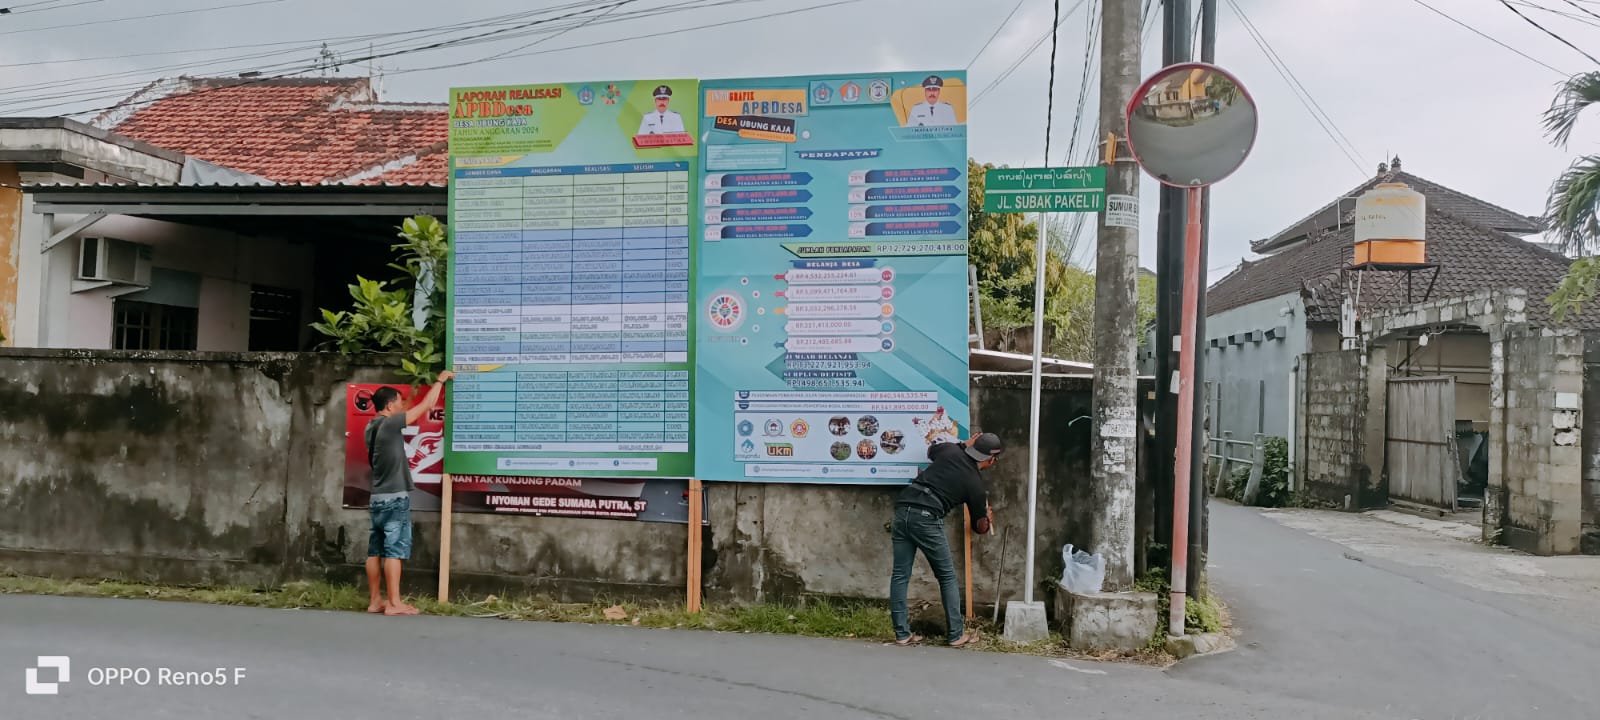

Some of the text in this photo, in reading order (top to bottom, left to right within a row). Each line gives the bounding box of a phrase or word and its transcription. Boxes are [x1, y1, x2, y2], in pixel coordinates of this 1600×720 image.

[456, 88, 562, 102] LAPORAN REALISASI
[452, 101, 533, 119] APBDesa
[717, 116, 791, 133] DESA UBUNG KAJA
[801, 150, 878, 159] PENDAPATAN
[997, 194, 1099, 209] JL. SUBAK PAKEL II
[1109, 201, 1133, 212] SUMUR
[451, 475, 582, 487] NAN TAK KUNJUNG PADAM
[485, 495, 647, 511] I NYOMAN GEDE SUMARA PUTRA, ST
